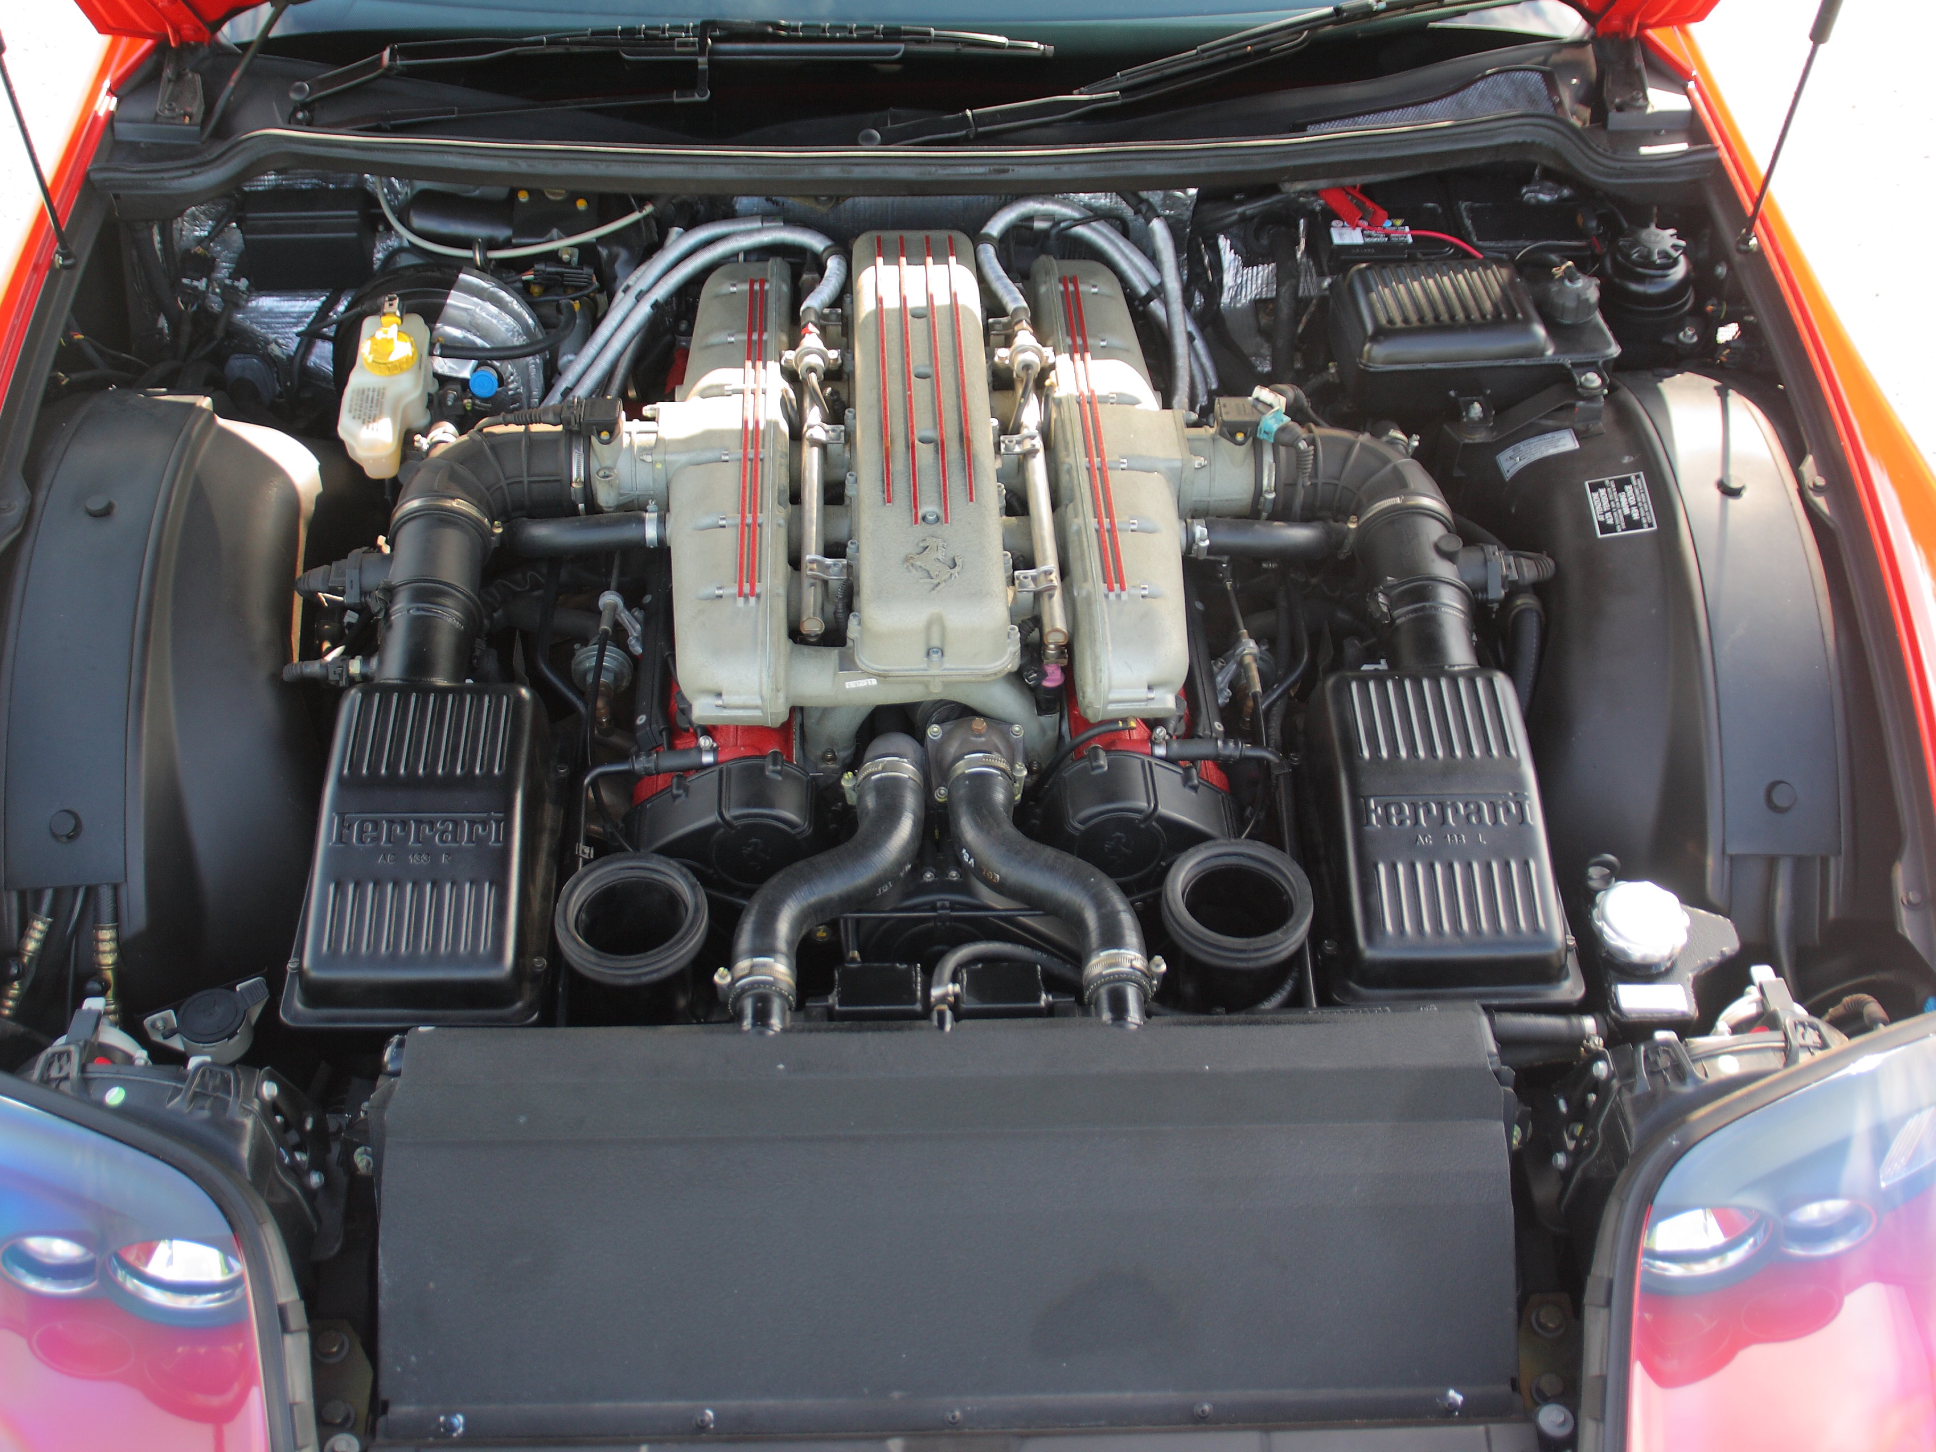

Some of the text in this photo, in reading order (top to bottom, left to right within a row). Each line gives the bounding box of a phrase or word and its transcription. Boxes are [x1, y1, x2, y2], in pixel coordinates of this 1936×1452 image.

[1361, 792, 1534, 829] Ferrari
[329, 812, 505, 847] Ferrari
[1416, 834, 1433, 846] AC
[1478, 833, 1487, 845] L
